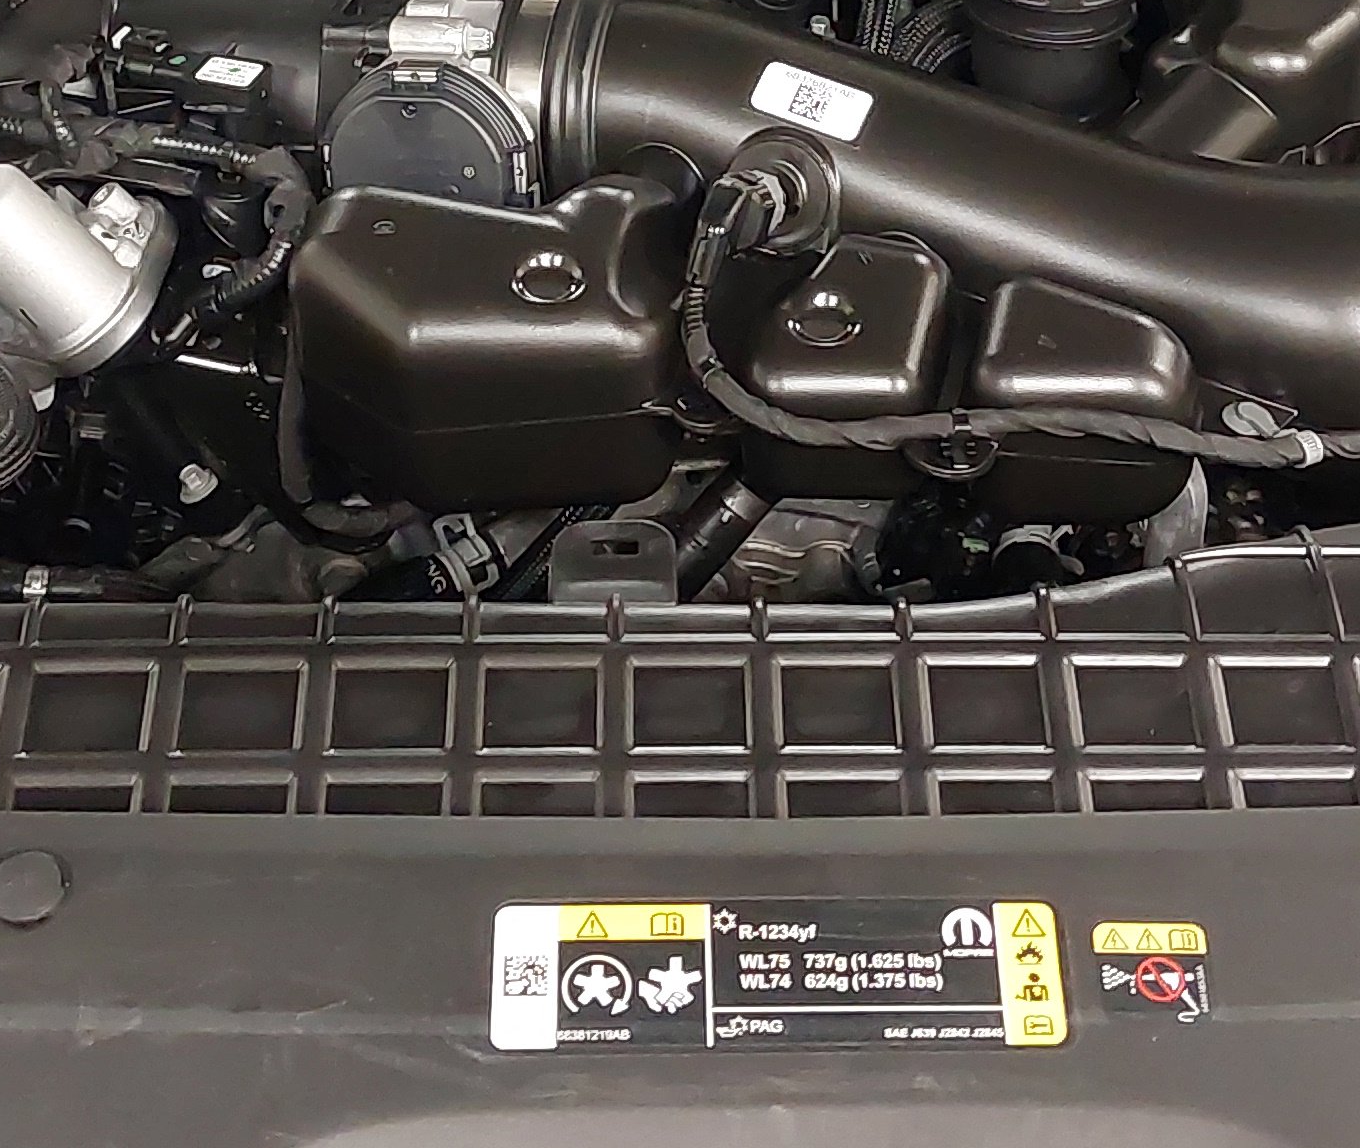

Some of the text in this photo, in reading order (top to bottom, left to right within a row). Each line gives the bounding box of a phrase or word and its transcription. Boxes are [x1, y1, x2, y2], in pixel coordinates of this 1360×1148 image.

[738, 924, 817, 943] R-1234yf
[739, 953, 942, 972] WL75 737g (1.625 lbs)
[740, 974, 944, 992] WL74 624g (1.375 lbs)
[750, 1019, 784, 1033] PAG
